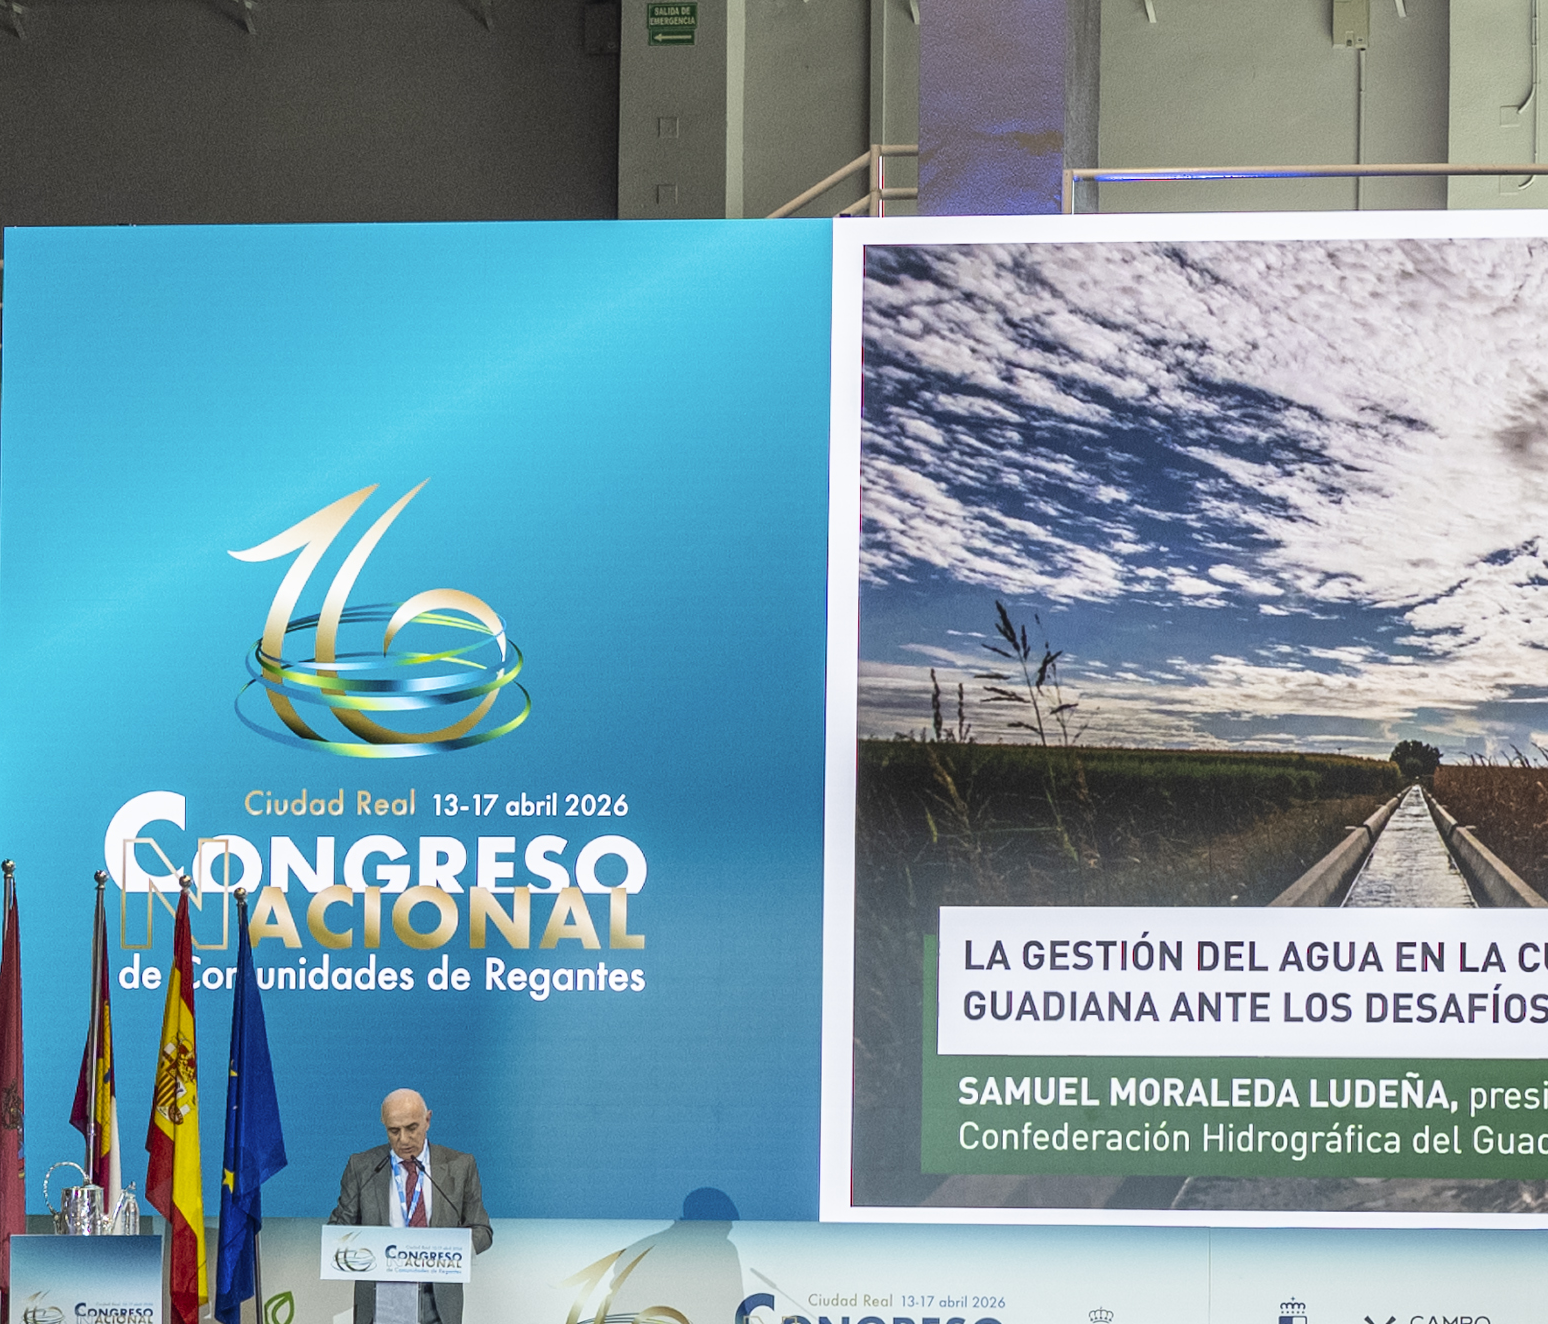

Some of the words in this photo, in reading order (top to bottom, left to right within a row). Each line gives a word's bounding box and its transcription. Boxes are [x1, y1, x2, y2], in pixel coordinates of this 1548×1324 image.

[244, 789, 344, 816] Ciudad
[357, 789, 415, 816] Real
[433, 793, 498, 816] 13-17
[506, 792, 558, 816] abril
[565, 793, 629, 817] 2026
[104, 790, 647, 894] CONGRESO
[121, 837, 646, 949] NACIONAL
[965, 940, 1010, 970] LA
[1023, 931, 1182, 971] GESTIÓN
[1198, 941, 1268, 971] DEL
[1279, 941, 1383, 972] AGUA
[1396, 942, 1444, 972] EN
[1460, 942, 1506, 972] LA
[118, 953, 162, 990] de
[192, 954, 414, 990] ounidades
[427, 955, 471, 990] de
[485, 958, 646, 998] Regantes
[964, 991, 1159, 1021] GUADIANA
[1170, 992, 1270, 1022] ANTE
[1284, 993, 1352, 1022] LOS
[959, 1077, 1099, 1105] SAMUEL
[1111, 1078, 1299, 1107] MORALEDA
[1310, 1072, 1457, 1113] LUDEÑA,
[960, 1121, 1189, 1151] Confederación
[1204, 1123, 1400, 1161] Hidrográfica
[1413, 1125, 1461, 1153] del
[385, 1244, 463, 1261] CONGRESO
[386, 1255, 462, 1269] NACIONAL
[75, 1302, 154, 1318] CONGRESO
[808, 1293, 857, 1306] Ciudad
[864, 1294, 892, 1307] Real
[902, 1295, 934, 1307] 13-17
[939, 1296, 967, 1308] abril
[973, 1296, 1006, 1308] 2026
